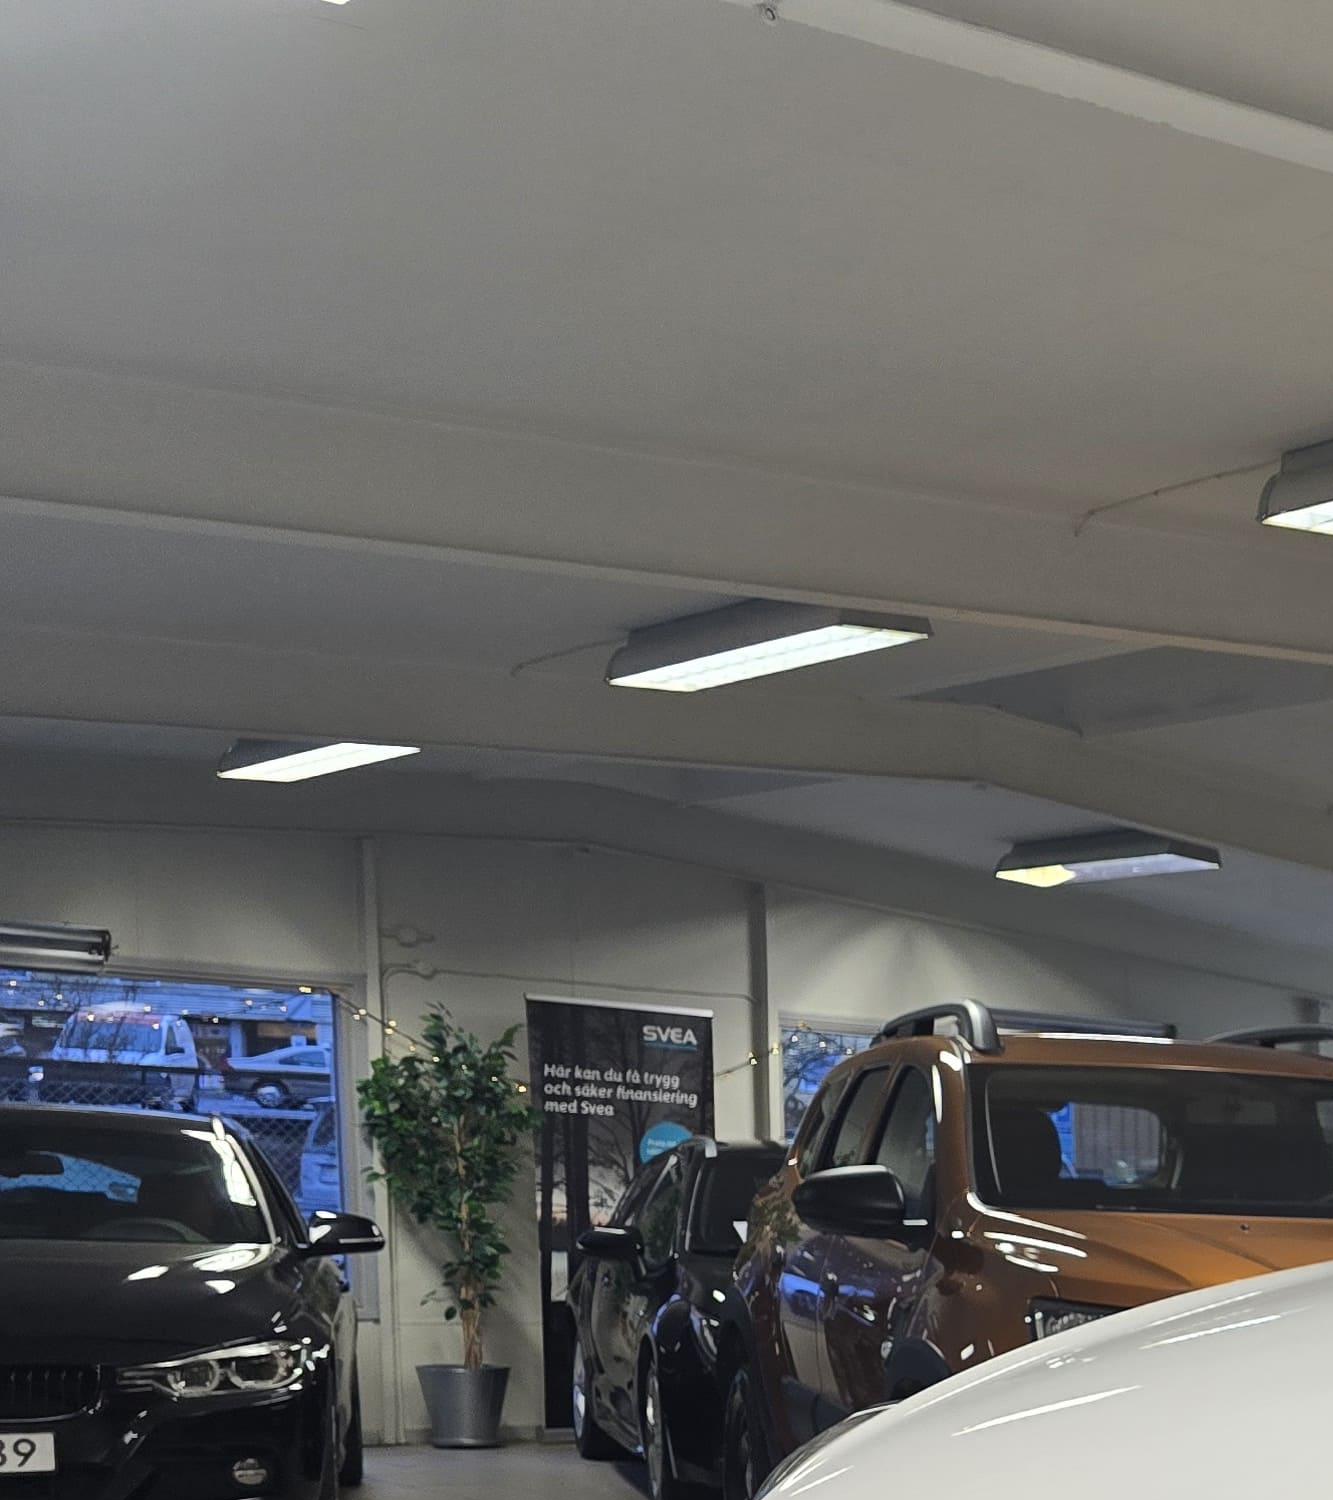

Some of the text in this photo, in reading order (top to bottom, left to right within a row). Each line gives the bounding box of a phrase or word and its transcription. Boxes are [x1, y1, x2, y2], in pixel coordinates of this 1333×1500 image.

[642, 1025, 698, 1045] SVEA
[543, 1063, 681, 1088] Här kan du få trygg
[543, 1081, 698, 1108] och säker finansiering
[544, 1100, 615, 1117] med Svea
